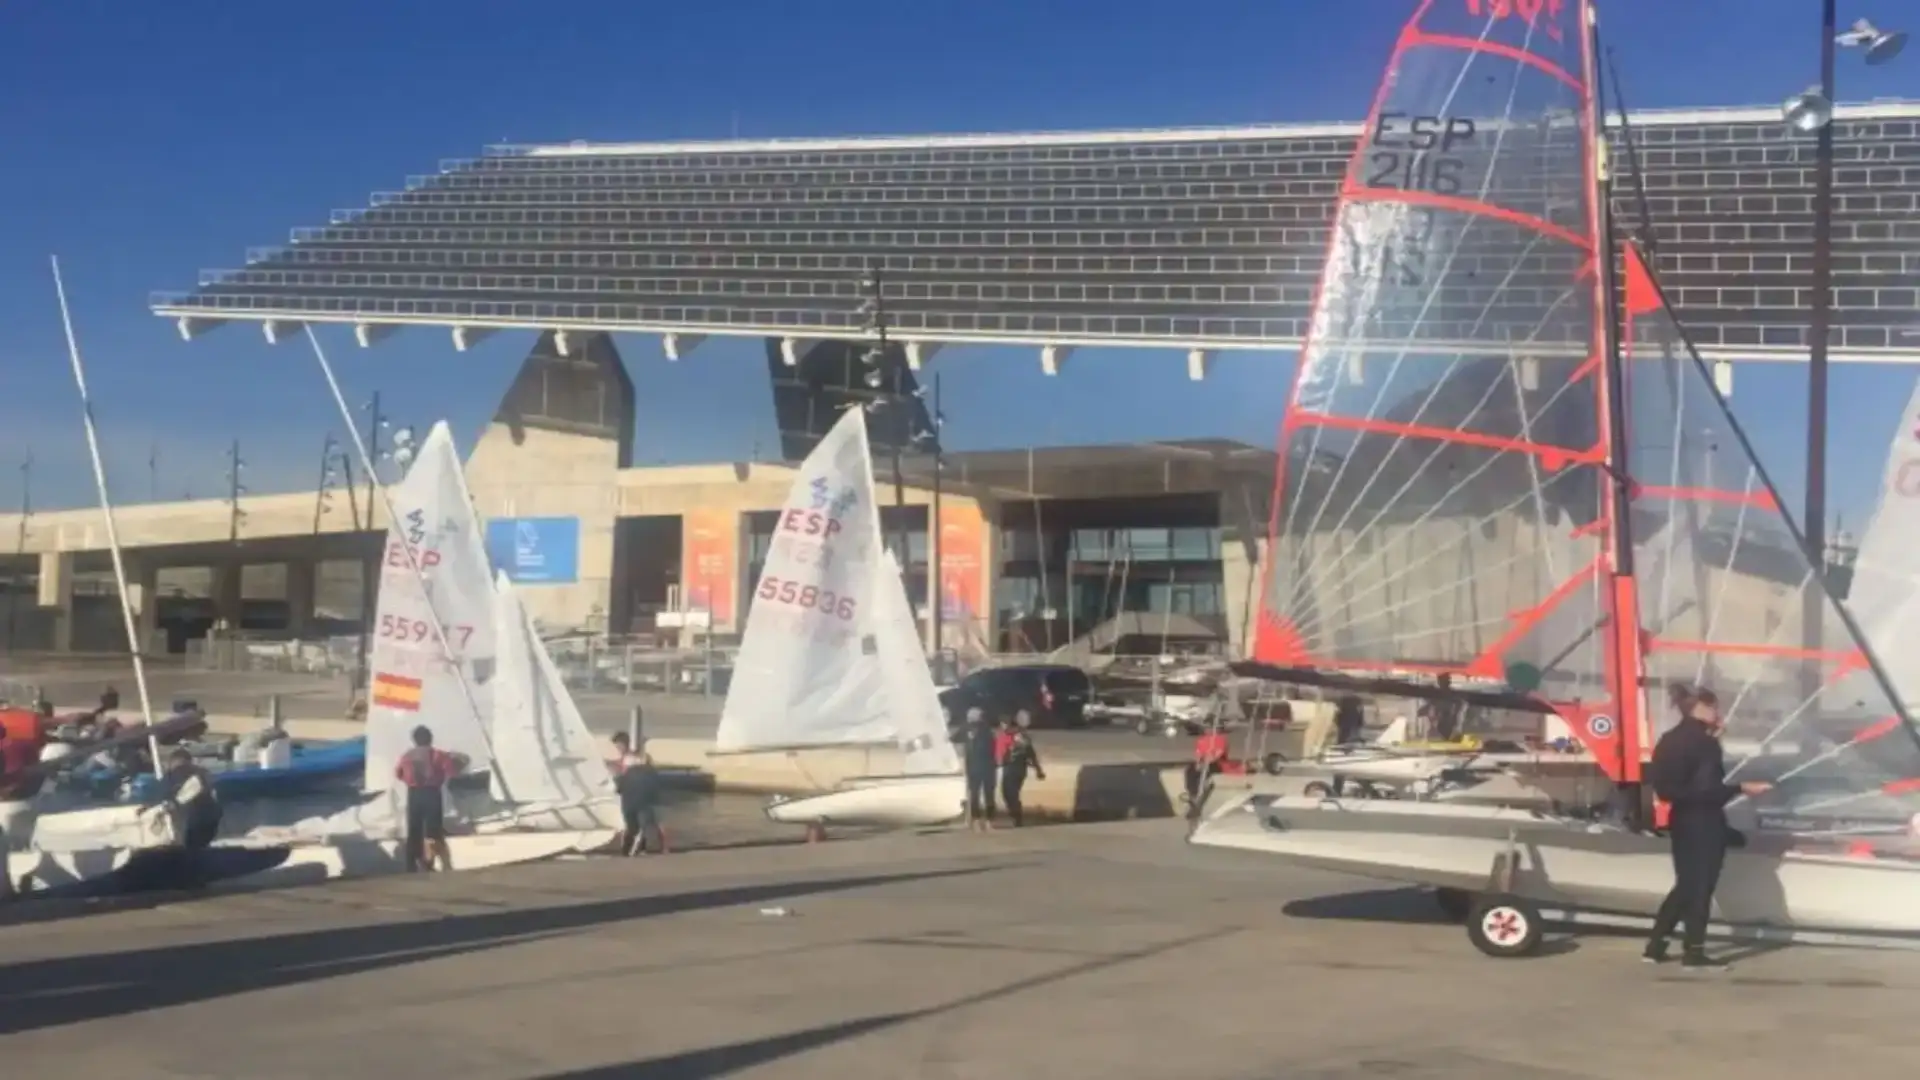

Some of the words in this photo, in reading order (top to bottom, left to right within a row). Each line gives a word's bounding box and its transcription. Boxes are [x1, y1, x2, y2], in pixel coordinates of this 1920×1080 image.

[1373, 112, 1475, 152] ESP
[1366, 151, 1464, 194] 2116
[784, 508, 842, 537] ESP
[759, 576, 857, 621] 55836
